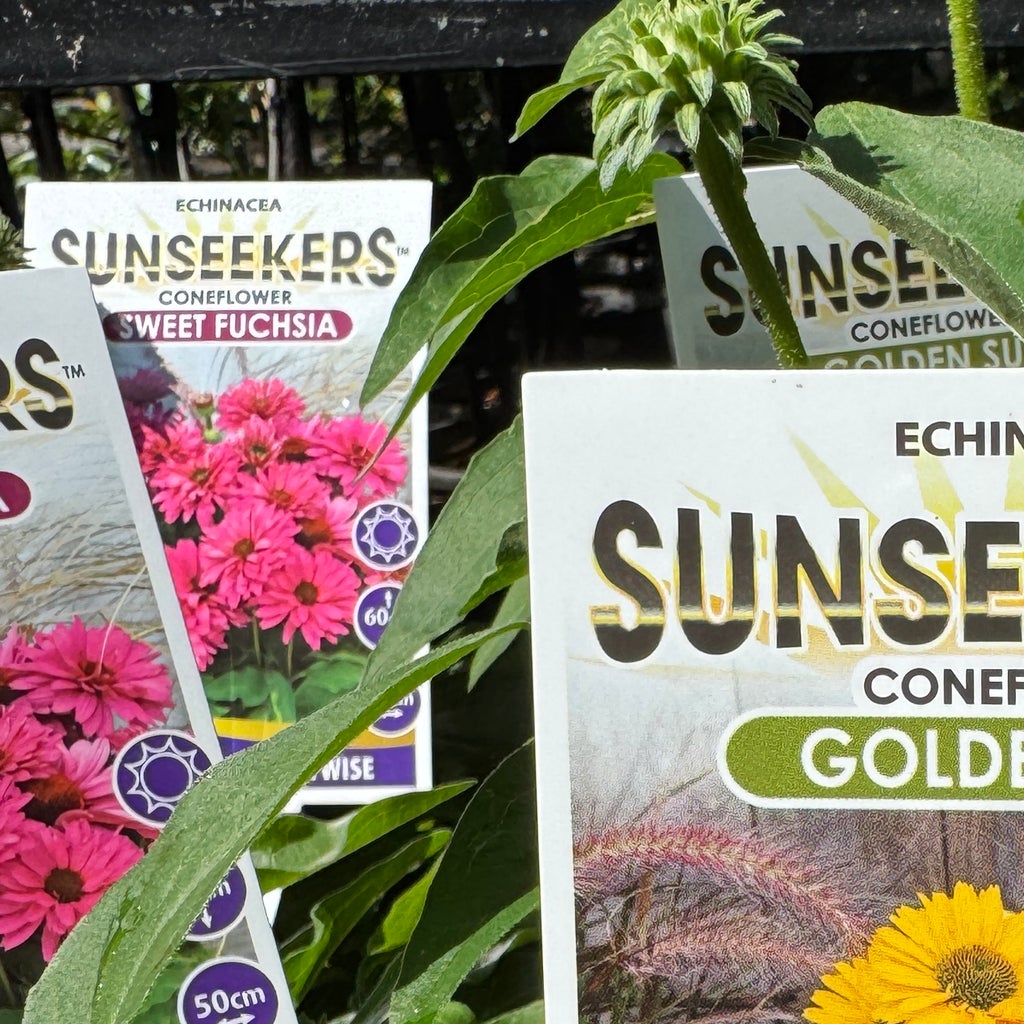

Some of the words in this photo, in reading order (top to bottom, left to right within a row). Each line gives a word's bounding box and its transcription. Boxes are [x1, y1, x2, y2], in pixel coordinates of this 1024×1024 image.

[176, 198, 282, 213] ECHINACEA
[52, 226, 398, 287] SUNSEEKERS
[159, 289, 293, 305] CONEFLOWER
[120, 312, 207, 339] SWEET
[215, 312, 338, 339] FUCHSIA
[824, 342, 972, 369] DEN
[321, 755, 375, 781] WISE
[193, 985, 267, 1020] 50cm
